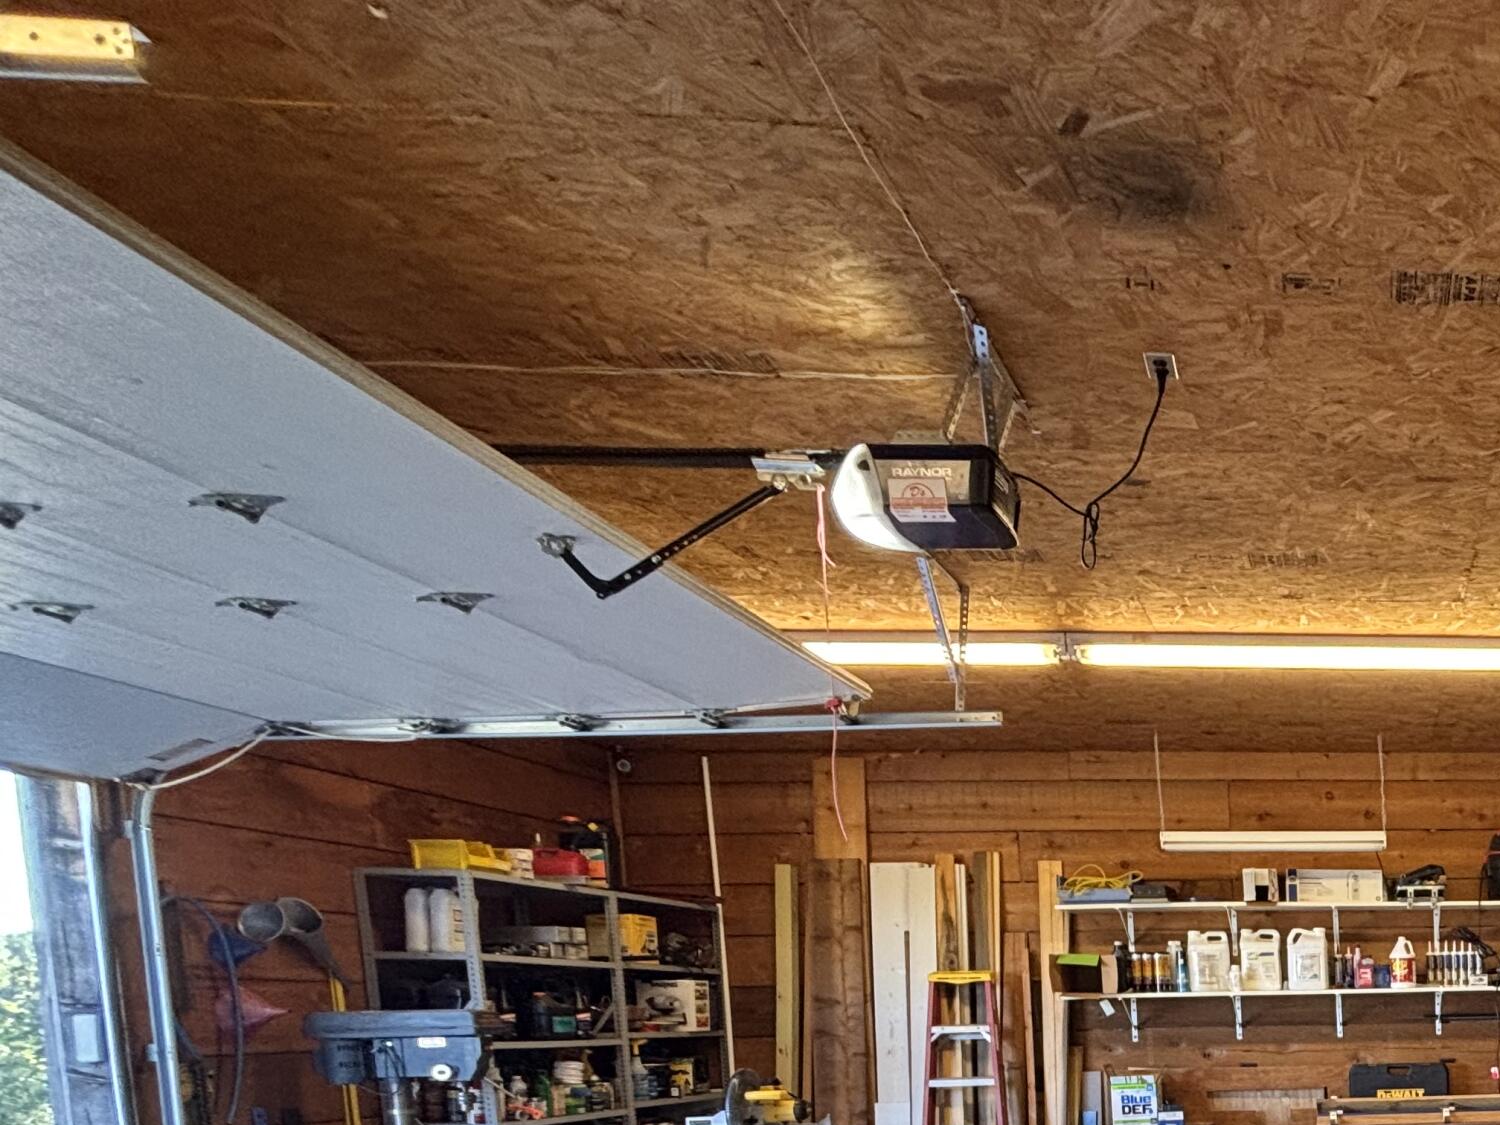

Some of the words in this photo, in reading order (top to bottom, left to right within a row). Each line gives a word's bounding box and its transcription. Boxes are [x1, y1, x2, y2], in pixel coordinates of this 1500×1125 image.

[892, 467, 952, 477] RAYNOR
[1121, 1094, 1152, 1105] Blue
[1121, 1104, 1152, 1115] DEF
